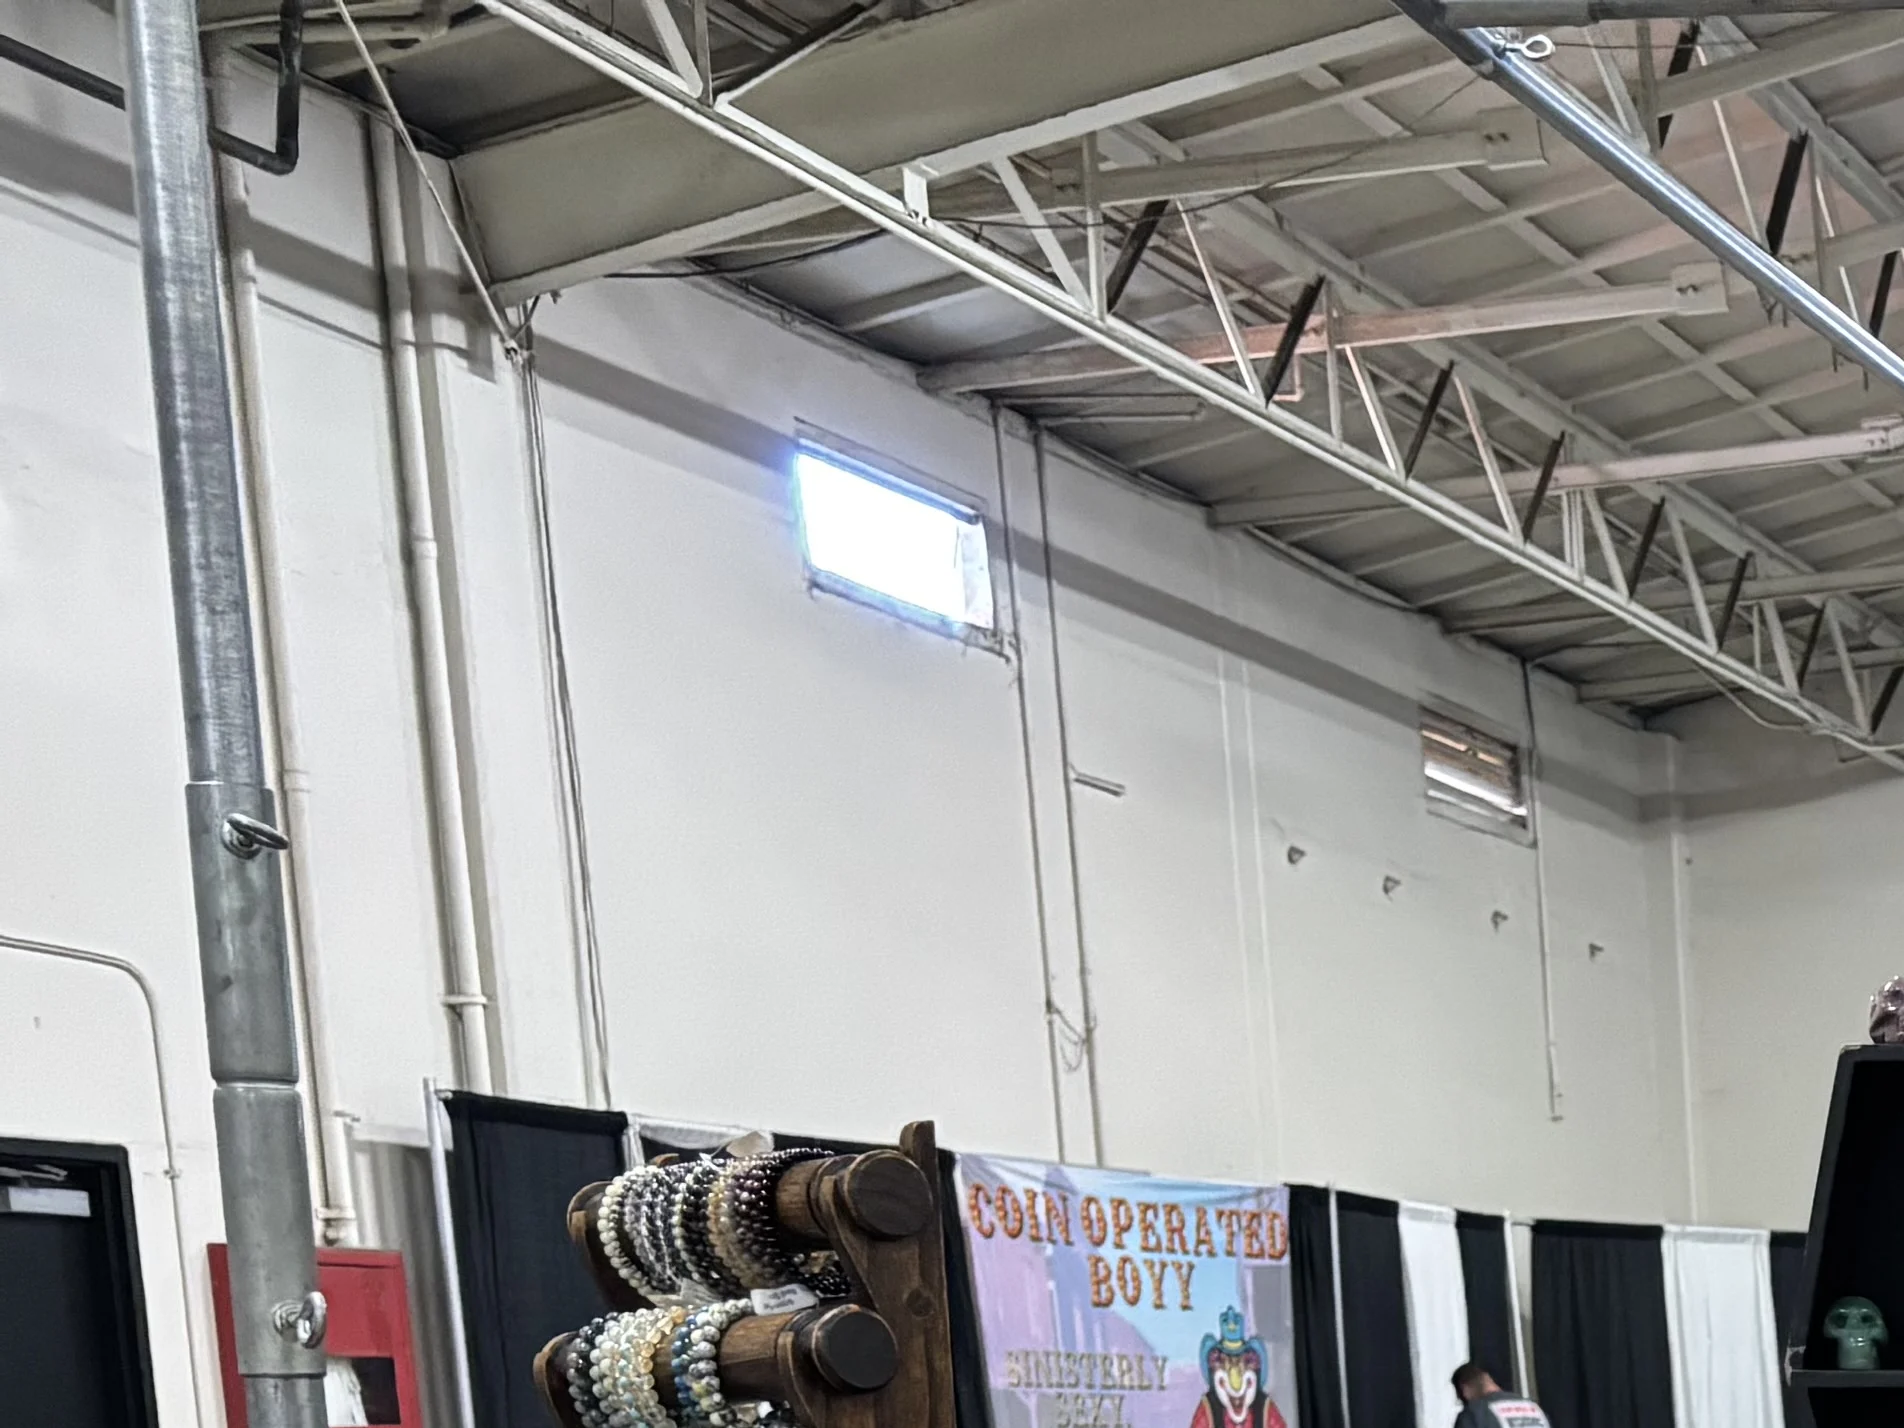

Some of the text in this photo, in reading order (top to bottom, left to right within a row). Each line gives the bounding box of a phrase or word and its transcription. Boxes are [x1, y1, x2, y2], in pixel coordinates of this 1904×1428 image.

[968, 1183, 1288, 1261] COIN OPERATED
[1088, 1253, 1196, 1311] BOYY
[1005, 1349, 1169, 1391] SINISTERLY
